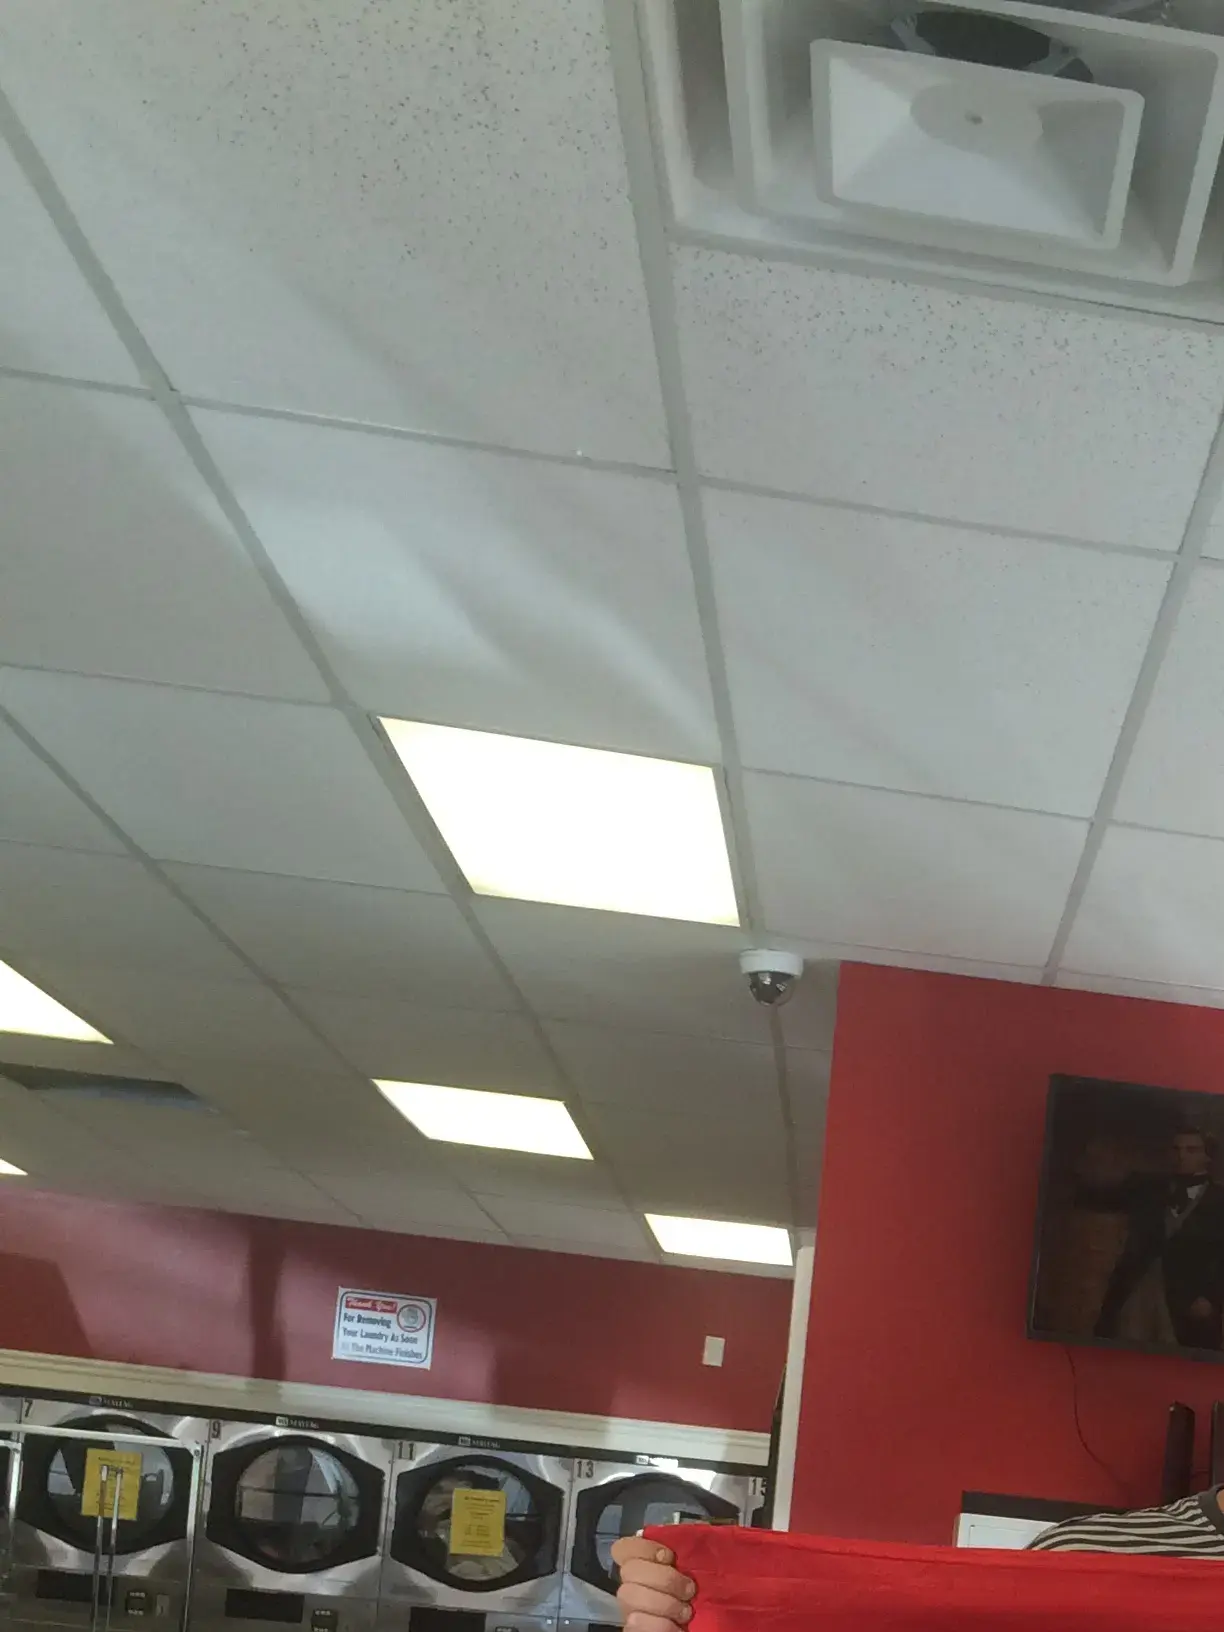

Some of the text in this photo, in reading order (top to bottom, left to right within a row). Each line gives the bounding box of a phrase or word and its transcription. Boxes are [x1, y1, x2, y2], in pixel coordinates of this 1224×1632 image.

[343, 1312, 355, 1322] For
[356, 1314, 391, 1329] Removing
[342, 1327, 418, 1344] Your Laundry As Soon
[366, 1344, 394, 1355] Machine
[395, 1347, 422, 1359] Finishes
[24, 1400, 33, 1417] 7
[211, 1420, 221, 1439] 9
[577, 1460, 594, 1478] 13
